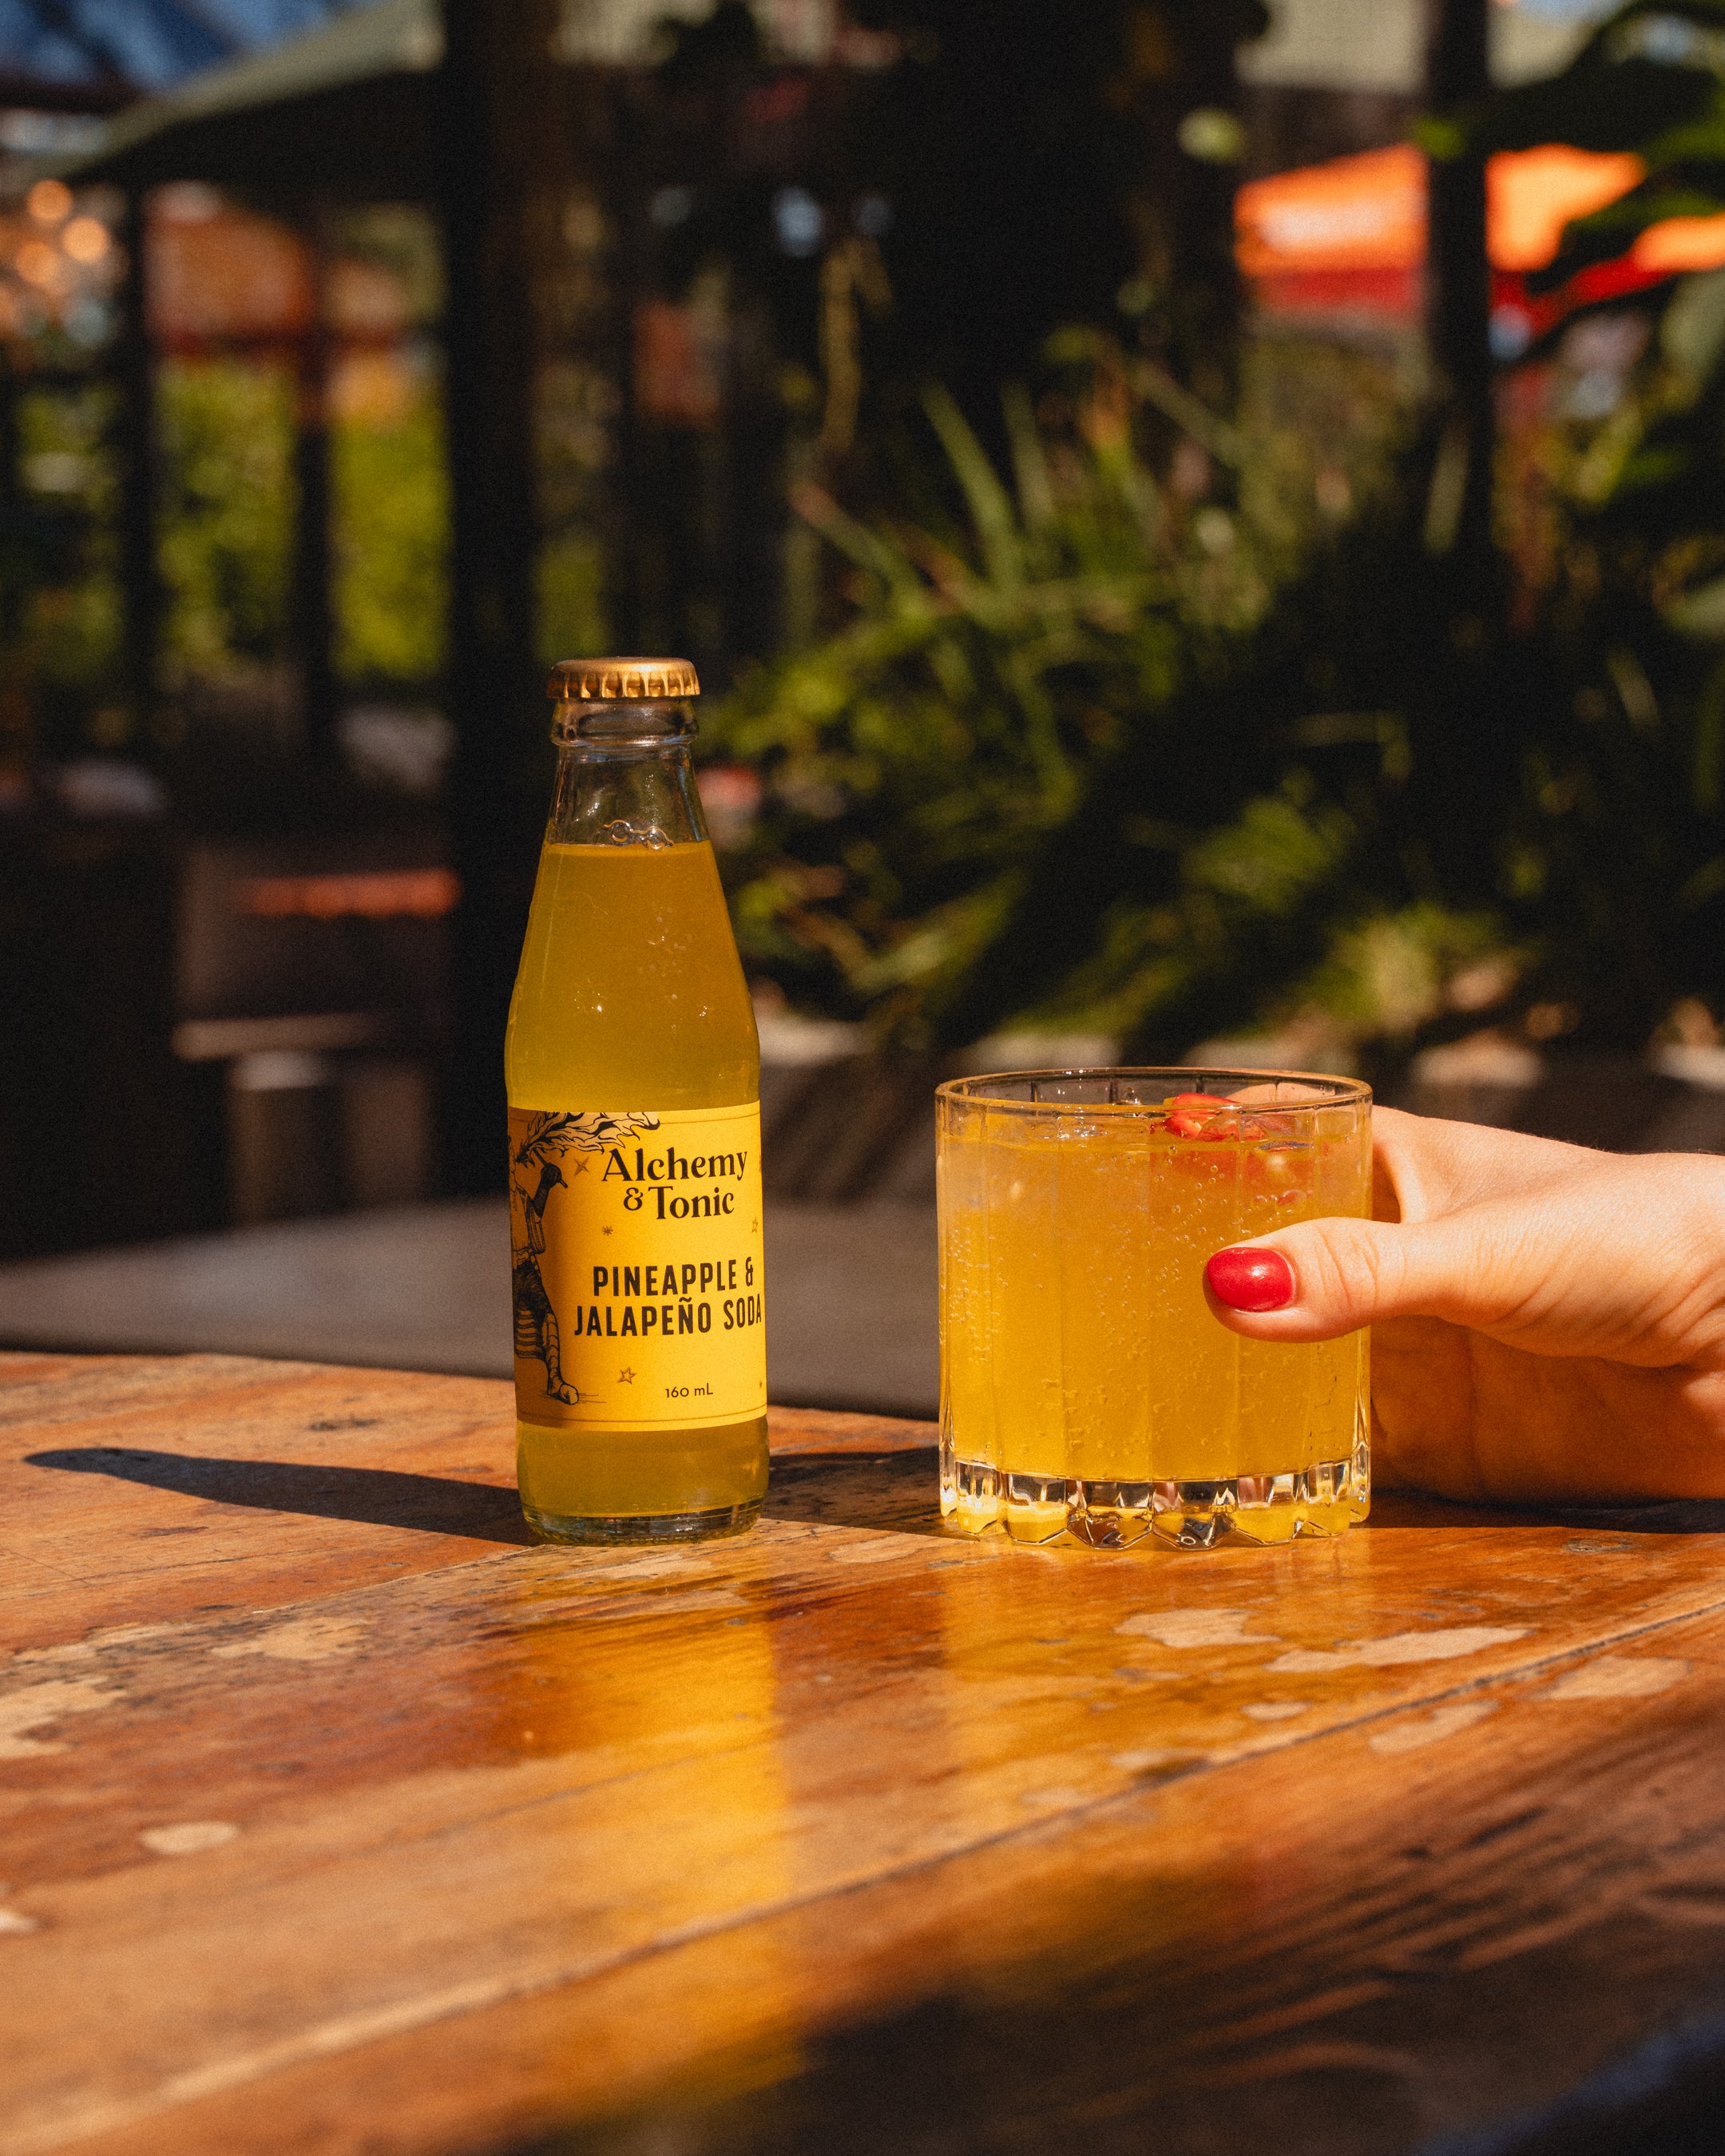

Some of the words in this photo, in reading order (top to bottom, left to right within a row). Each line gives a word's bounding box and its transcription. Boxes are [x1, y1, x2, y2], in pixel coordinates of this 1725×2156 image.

[601, 1147, 748, 1182] Alchemy
[648, 1186, 735, 1220] Tonic
[593, 1259, 737, 1297] PINEAPPLE
[745, 1256, 755, 1286] &
[574, 1297, 712, 1337] JALAPEÑO
[724, 1293, 762, 1331] SODA
[665, 1385, 689, 1399] 160
[694, 1382, 714, 1397] mL
